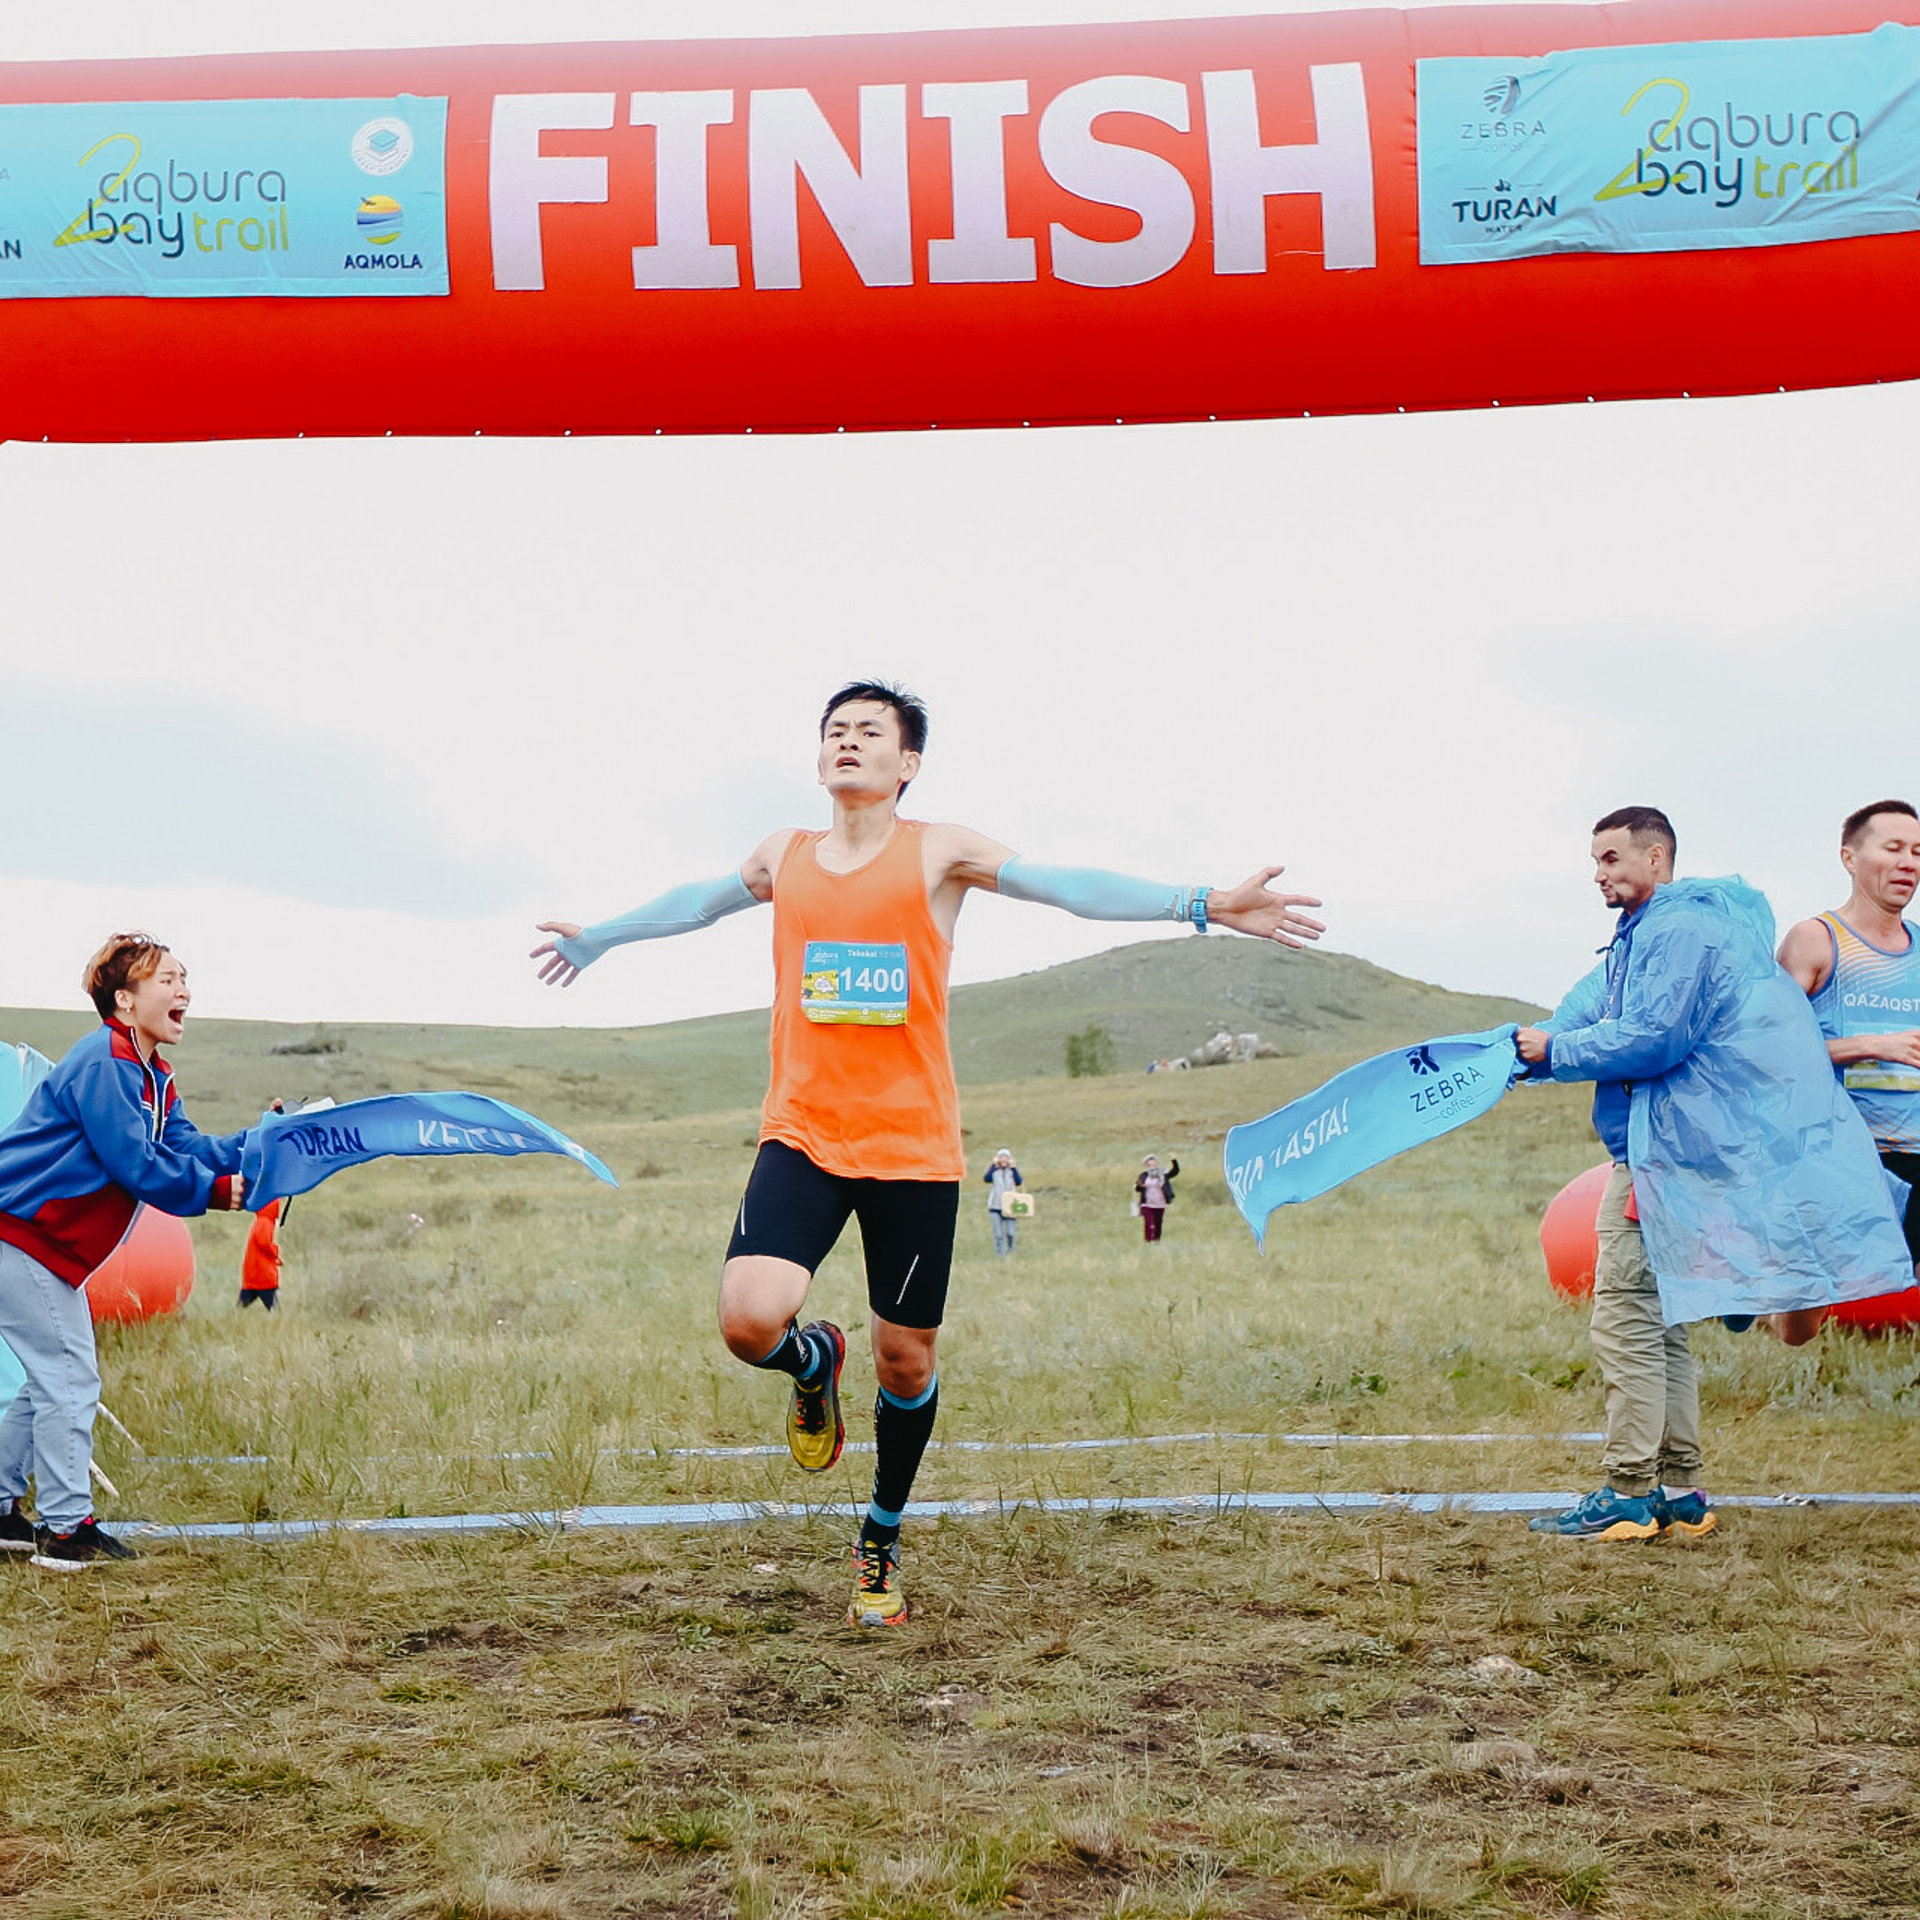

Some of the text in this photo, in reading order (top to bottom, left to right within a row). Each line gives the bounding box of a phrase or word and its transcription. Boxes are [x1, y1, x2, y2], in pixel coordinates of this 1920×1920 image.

[1461, 120, 1546, 139] ZEBRA
[1648, 102, 1861, 162] aqbura
[99, 158, 287, 214] aqbura
[489, 62, 1377, 290] FINISH
[1636, 148, 1743, 208] bay
[88, 198, 289, 258] bay trail
[1451, 195, 1557, 223] TURAN
[344, 253, 423, 270] AQMOLA
[841, 966, 905, 992] 1400
[1410, 1066, 1485, 1113] ZEBRA
[1440, 1095, 1476, 1119] coffee
[277, 1126, 370, 1156] TURAN
